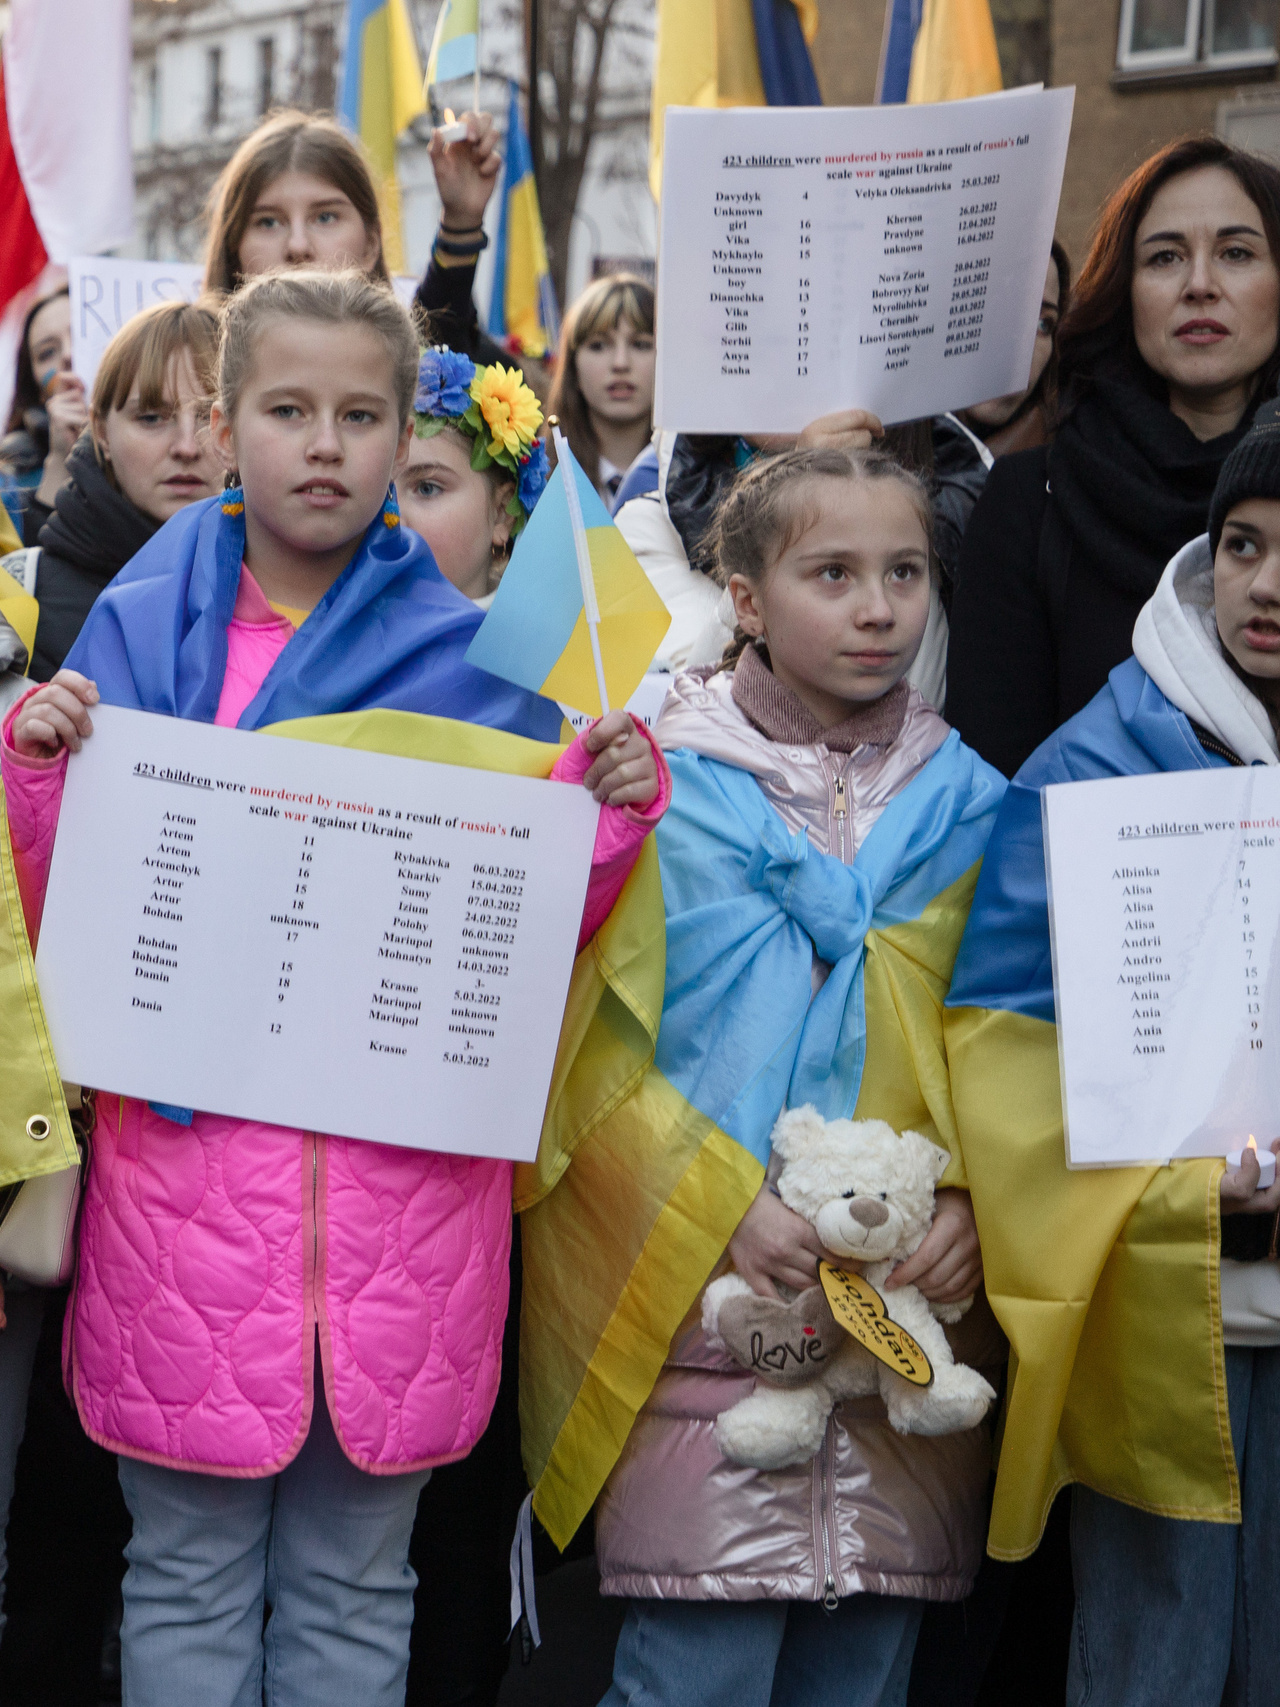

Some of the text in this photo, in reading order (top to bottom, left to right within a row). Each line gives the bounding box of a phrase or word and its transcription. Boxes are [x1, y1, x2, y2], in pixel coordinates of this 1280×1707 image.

[722, 133, 1030, 166] 423 children were murdered by russia as a result of russia's full
[827, 161, 953, 180] scale war against Ukraine
[715, 191, 761, 204] Davydyk
[714, 206, 763, 217] Unknown
[729, 219, 747, 233] girl
[726, 234, 750, 245] Vika
[712, 249, 763, 262] Mykhaylo
[713, 264, 762, 275] Unknown
[728, 277, 746, 291] boy
[710, 292, 764, 303] Dianochka
[725, 307, 748, 318] Vika
[725, 321, 747, 332] Glib
[721, 336, 751, 347] Serhii
[722, 351, 749, 363] Anya
[721, 365, 750, 375] Sasha
[572, 716, 583, 726] of
[133, 761, 530, 840] 423 children were murdered by russia as a result of russia's full
[162, 811, 196, 826] Artem
[249, 804, 413, 841] scale war against Ukraine
[160, 827, 193, 842] Artem
[1118, 825, 1141, 838] 423
[1145, 822, 1199, 836] children
[1203, 820, 1235, 831] were
[1243, 836, 1275, 847] scale
[157, 842, 190, 858] Artem
[142, 856, 200, 877] Artemchyk
[394, 850, 450, 869] Rybakivka
[398, 867, 441, 884] Kharkiv
[473, 863, 526, 881] 06.03.2022
[1112, 866, 1160, 880] Albinka
[153, 874, 184, 890] Artur
[471, 879, 523, 897] 15.04.2022
[1122, 884, 1152, 896] Alisa
[150, 890, 181, 906] Artur
[401, 884, 431, 902] Sumy
[398, 901, 428, 915] Izium
[468, 895, 520, 913] 07.03.2022
[1123, 901, 1153, 914] Alisa
[143, 904, 182, 922] Bohdan
[464, 911, 517, 929] 24.02.2022
[393, 916, 429, 934] Polohy
[1125, 919, 1155, 931] Alisa
[137, 934, 177, 952] Bohdan
[383, 931, 432, 950] Mariupol
[462, 927, 514, 945] 06.03.2022
[1121, 936, 1161, 949] Andrii
[132, 949, 177, 969] Bohdana
[378, 947, 431, 966] Mohnatyn
[462, 945, 508, 960] unknown
[1123, 954, 1162, 967] Andro
[135, 966, 169, 983] Damin
[457, 959, 509, 976] 14.03.2022
[380, 978, 418, 994] Krasne
[1117, 971, 1171, 987] Angelina
[372, 993, 421, 1011] Mariupol
[454, 990, 500, 1006] 5.03.2022
[1131, 989, 1159, 1002] Ania
[132, 996, 162, 1013] Dania
[369, 1009, 418, 1027] Mariupol
[451, 1007, 497, 1022] unknown
[1132, 1007, 1161, 1019] Ania
[449, 1023, 494, 1038] unknown
[1133, 1024, 1162, 1037] Ania
[369, 1040, 407, 1056] Krasne
[1133, 1044, 1165, 1056] Anna
[443, 1051, 489, 1068] 5.03.2022
[827, 1268, 916, 1375] Bohdan
